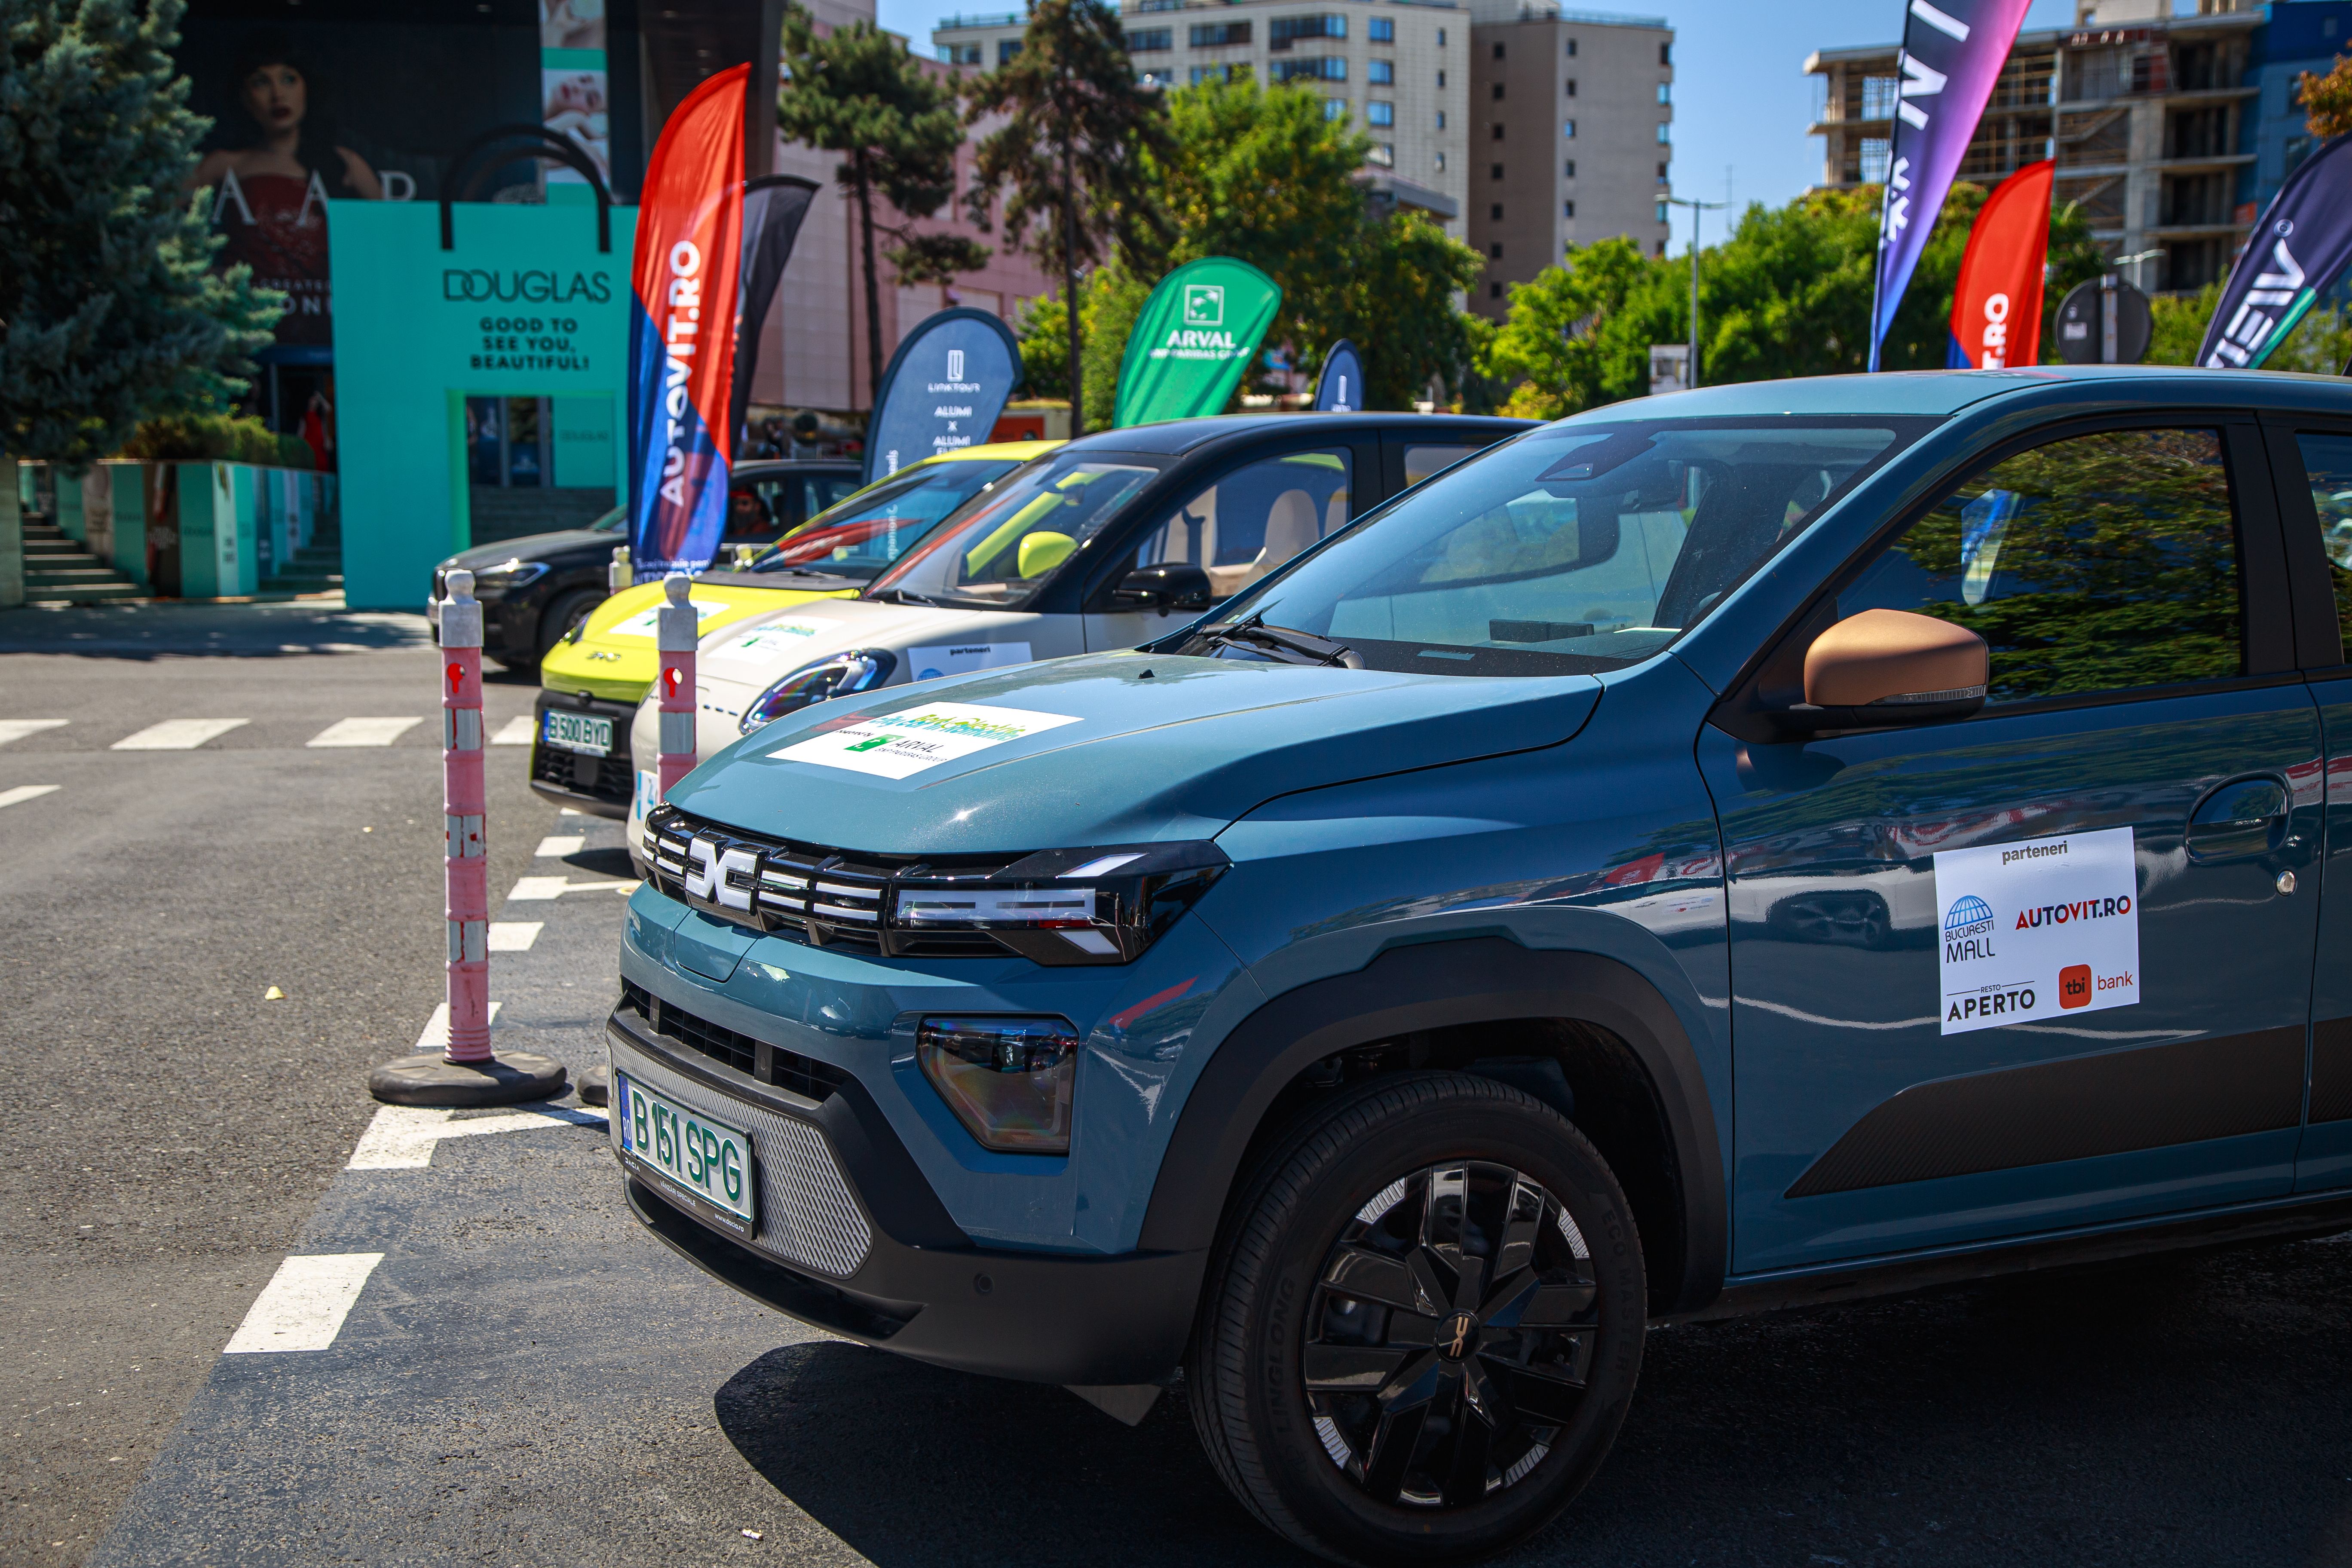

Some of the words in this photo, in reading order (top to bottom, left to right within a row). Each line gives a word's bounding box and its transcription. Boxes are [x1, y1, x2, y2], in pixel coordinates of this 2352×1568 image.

[443, 269, 611, 303] DOUGLAS
[479, 316, 544, 333] GOOD
[549, 317, 578, 334] TO
[482, 335, 519, 352] SEE
[526, 336, 576, 353] YOU,
[1166, 330, 1237, 349] ARVAL
[470, 353, 590, 371] BEAUTIFUL!
[660, 240, 701, 508] AUTOVIT.RO
[934, 406, 972, 417] ALUMI
[947, 420, 958, 432] X
[932, 435, 971, 447] ALUMI
[949, 646, 991, 656] parteneri
[548, 712, 557, 738] B
[559, 714, 580, 741] 500
[583, 717, 611, 745] BYD
[889, 740, 944, 753] ARVAL
[2002, 840, 2068, 865] parteneri
[2015, 895, 2132, 931] AUTOVIT.RO
[1945, 919, 1994, 943] BUCURESTI
[1946, 937, 1996, 964] MALL
[1980, 984, 2001, 994] RESTO
[2065, 977, 2086, 995] tbi
[2097, 971, 2133, 991] bank
[1947, 989, 2036, 1022] APERTO
[623, 1115, 632, 1141] RO
[633, 1087, 649, 1152] B
[652, 1100, 681, 1174] 151
[686, 1120, 741, 1202] SPG
[625, 1157, 640, 1173] DACIA
[660, 1180, 677, 1196] VÂNZĂRI
[677, 1190, 696, 1207] SPECIALE
[714, 1212, 744, 1233] www.dacia.ro
